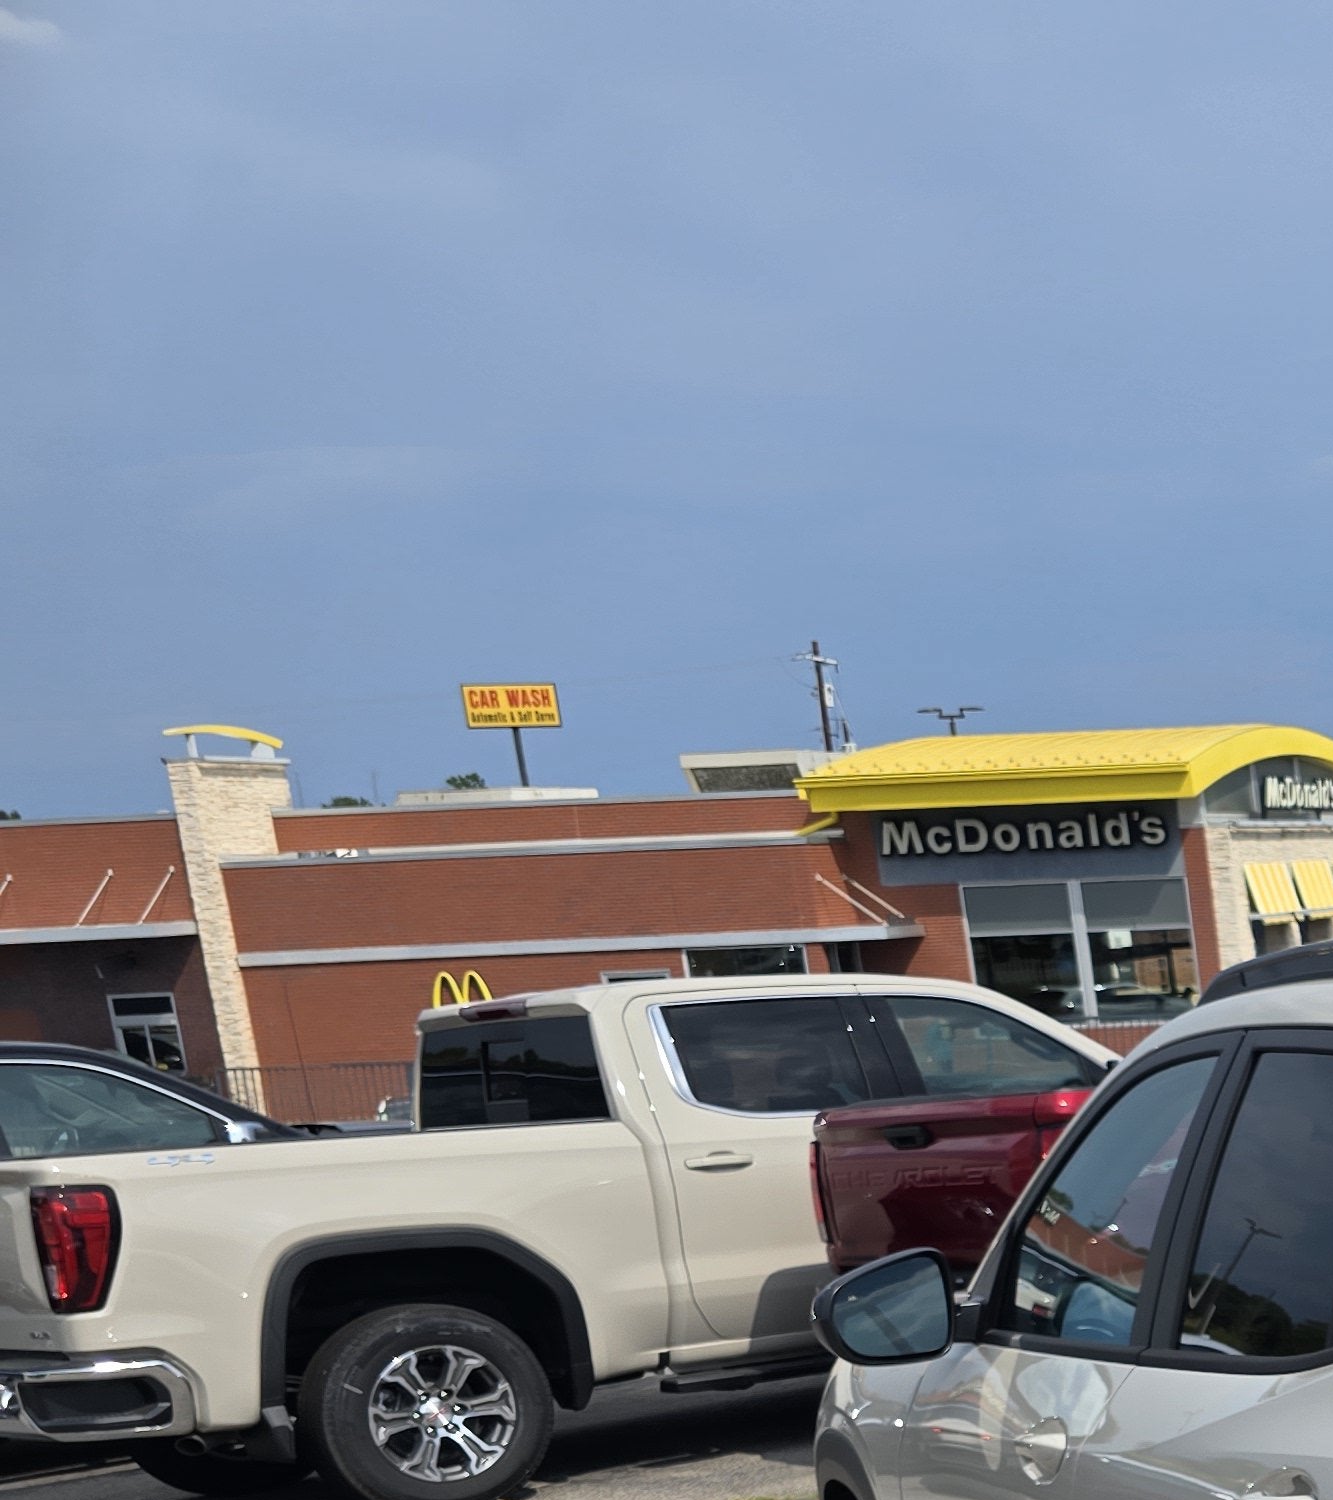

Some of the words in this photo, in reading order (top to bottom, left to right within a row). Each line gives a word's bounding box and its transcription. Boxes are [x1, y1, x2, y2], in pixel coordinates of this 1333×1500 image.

[469, 689, 500, 709] CAR
[505, 688, 552, 708] WASH
[881, 811, 1167, 856] McDonald's
